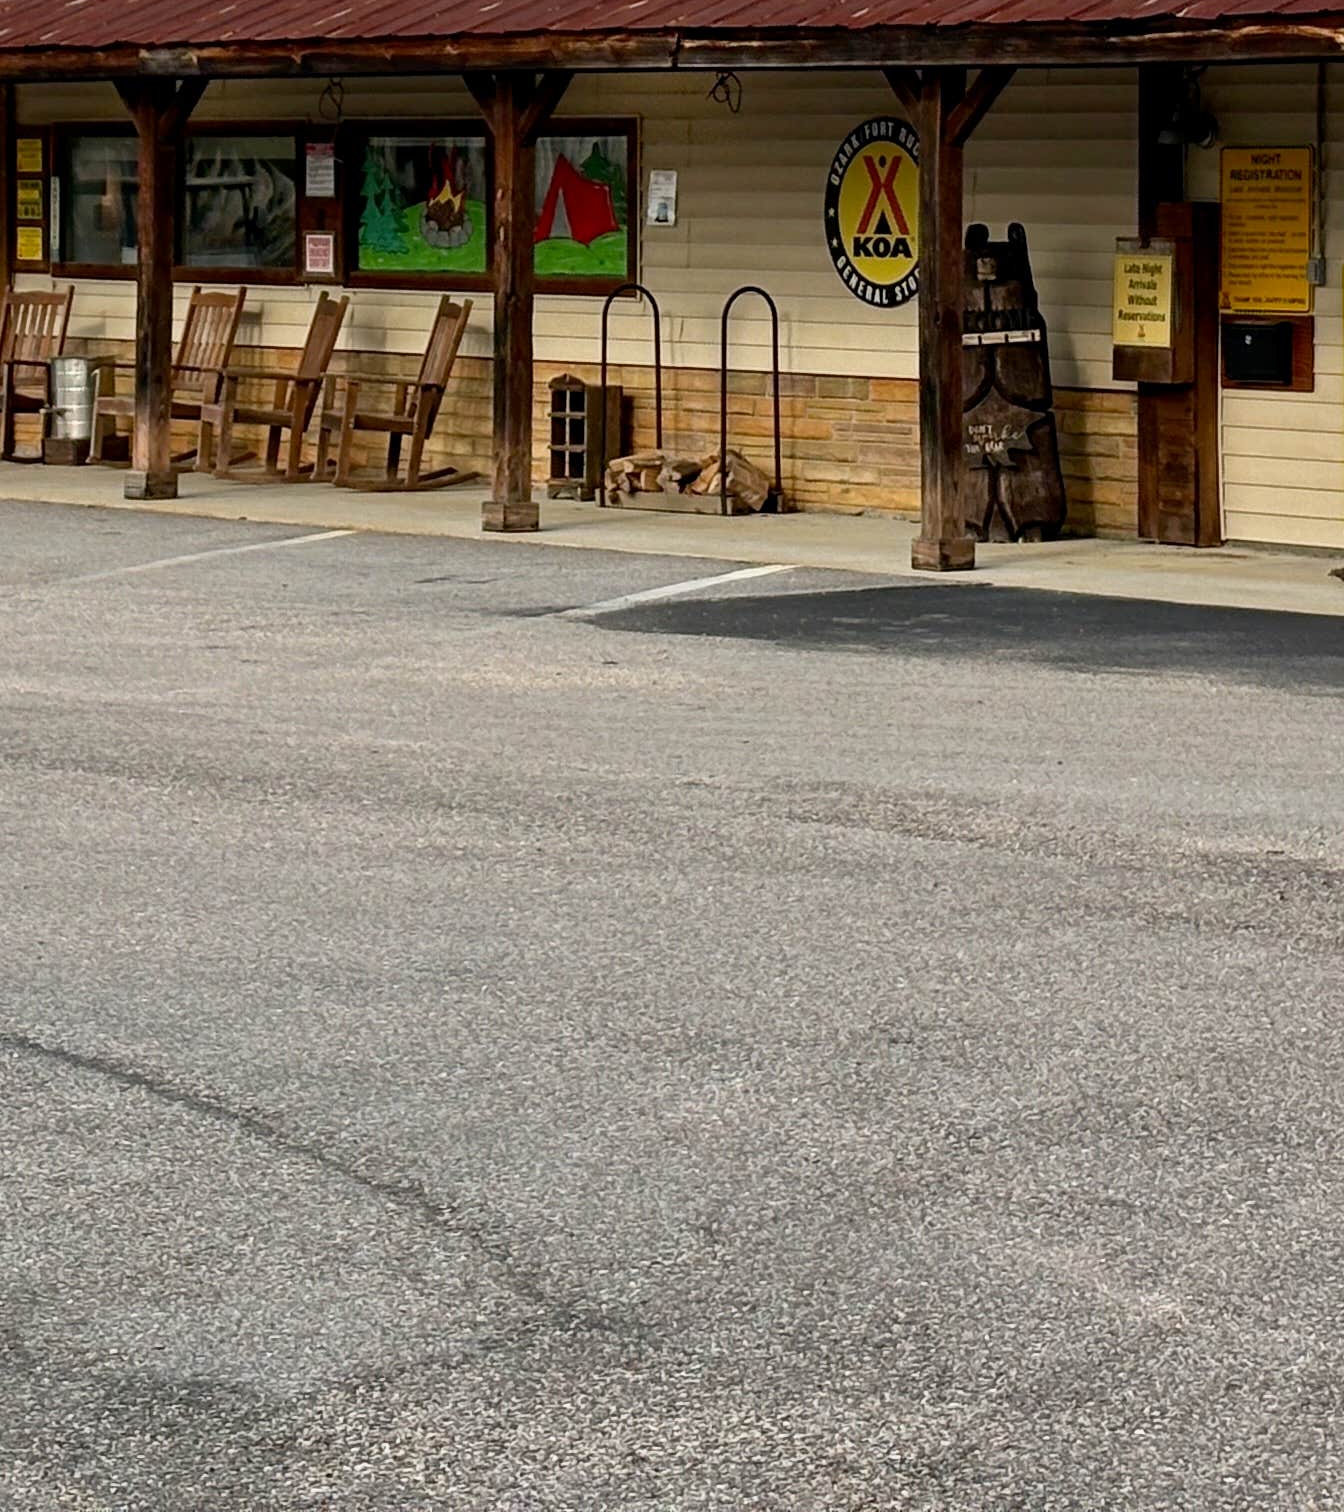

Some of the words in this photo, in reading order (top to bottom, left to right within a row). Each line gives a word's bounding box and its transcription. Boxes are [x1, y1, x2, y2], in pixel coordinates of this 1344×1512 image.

[898, 127, 920, 157] RUC
[1250, 153, 1281, 164] NIGHT
[1229, 169, 1303, 180] REGISTRATION
[853, 236, 913, 258] KOA
[836, 255, 889, 305] GENERAL
[894, 268, 920, 301] STO
